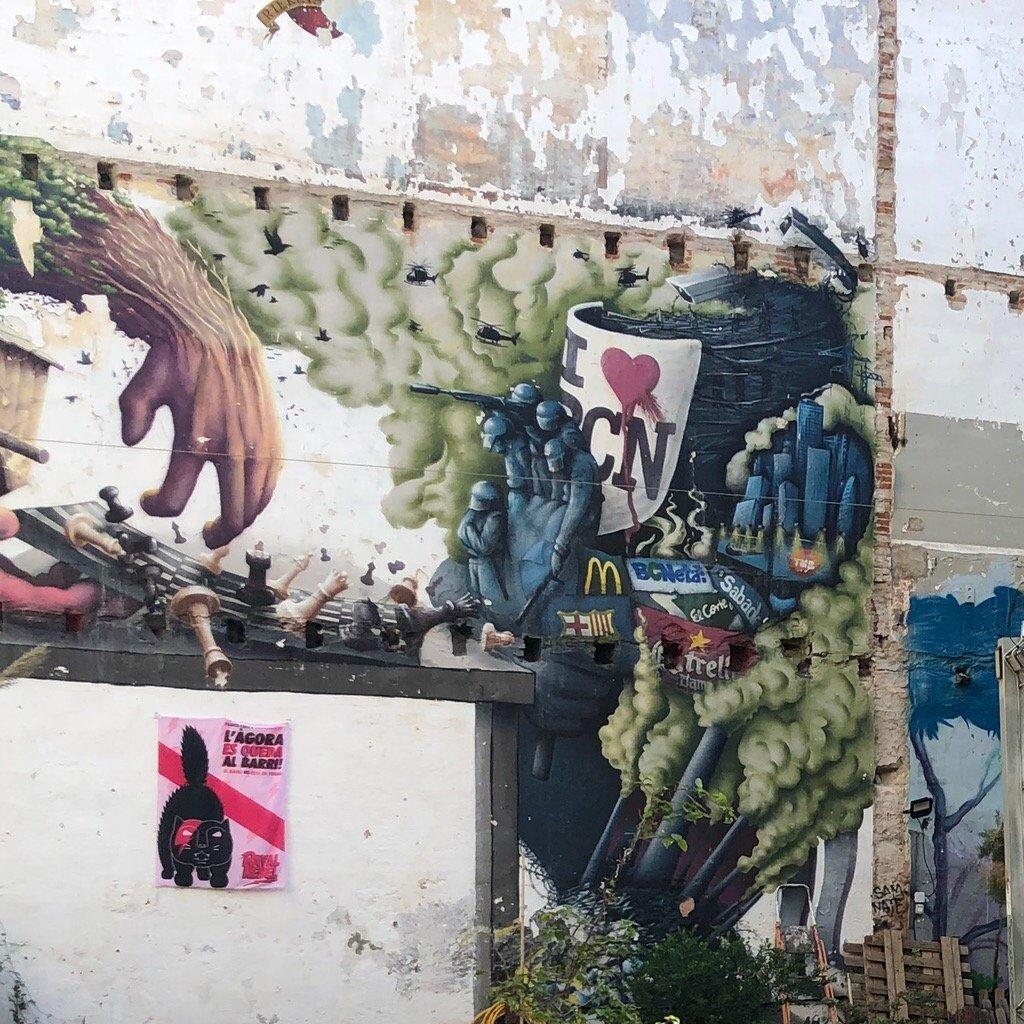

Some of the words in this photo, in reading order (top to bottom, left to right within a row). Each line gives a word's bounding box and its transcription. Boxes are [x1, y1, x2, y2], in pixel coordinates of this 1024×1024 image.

[561, 329, 588, 389] I
[240, 745, 283, 758] QUEDA
[222, 756, 237, 768] AL
[241, 757, 283, 770] BARRI!
